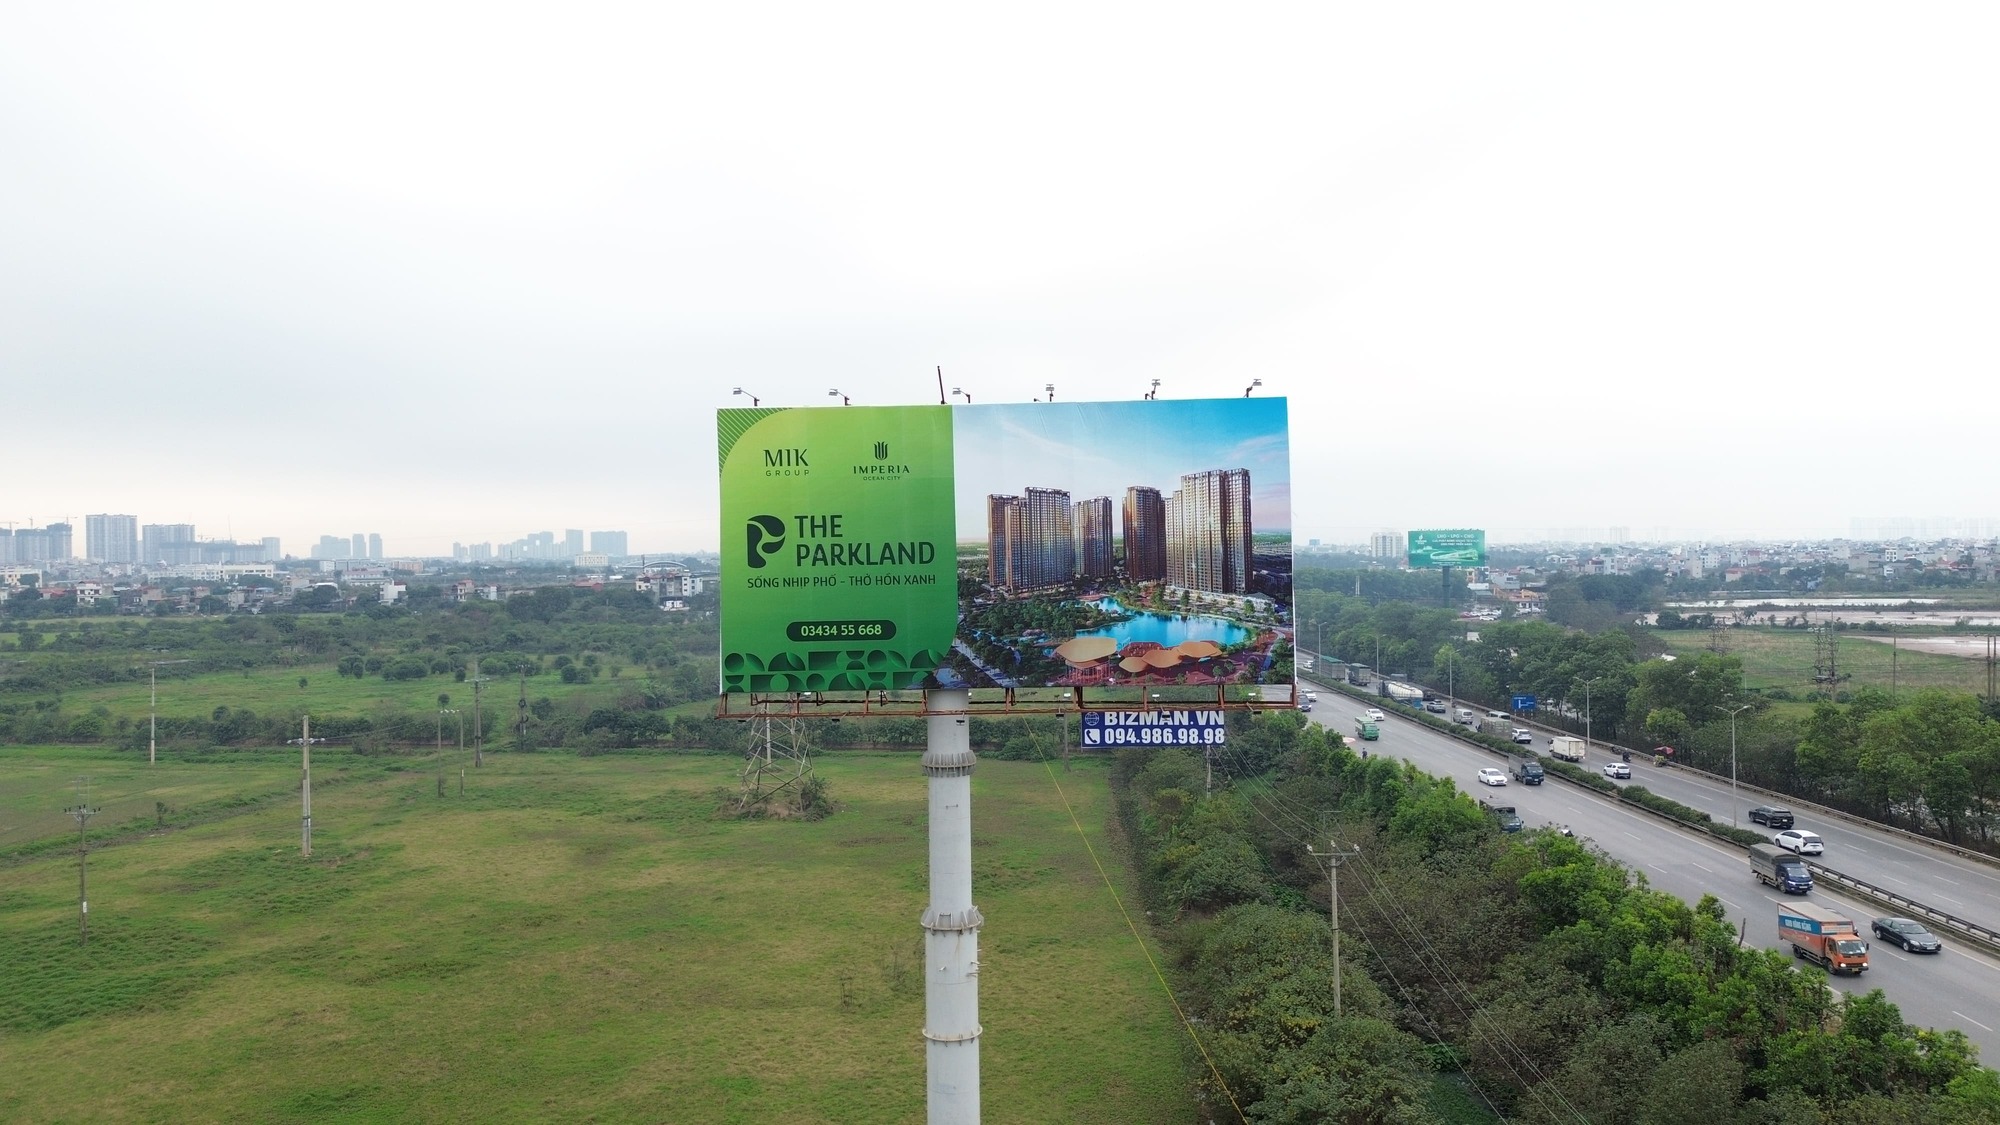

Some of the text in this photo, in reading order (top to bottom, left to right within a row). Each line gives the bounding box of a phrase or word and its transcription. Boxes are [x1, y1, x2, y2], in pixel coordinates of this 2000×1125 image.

[763, 448, 809, 467] MIK
[853, 465, 910, 474] IMPERIA
[794, 514, 843, 538] THE
[796, 541, 935, 567] PARKLAND
[747, 575, 779, 589] SỐNG
[782, 577, 810, 590] NHỊP
[813, 574, 837, 587] PHỐ
[875, 572, 901, 586] HỒN
[904, 574, 936, 586] XANH
[801, 624, 882, 637] 03434 55 668
[1105, 711, 1224, 725] BIZMAN.VN
[1104, 728, 1225, 744] 094.986.98.98
